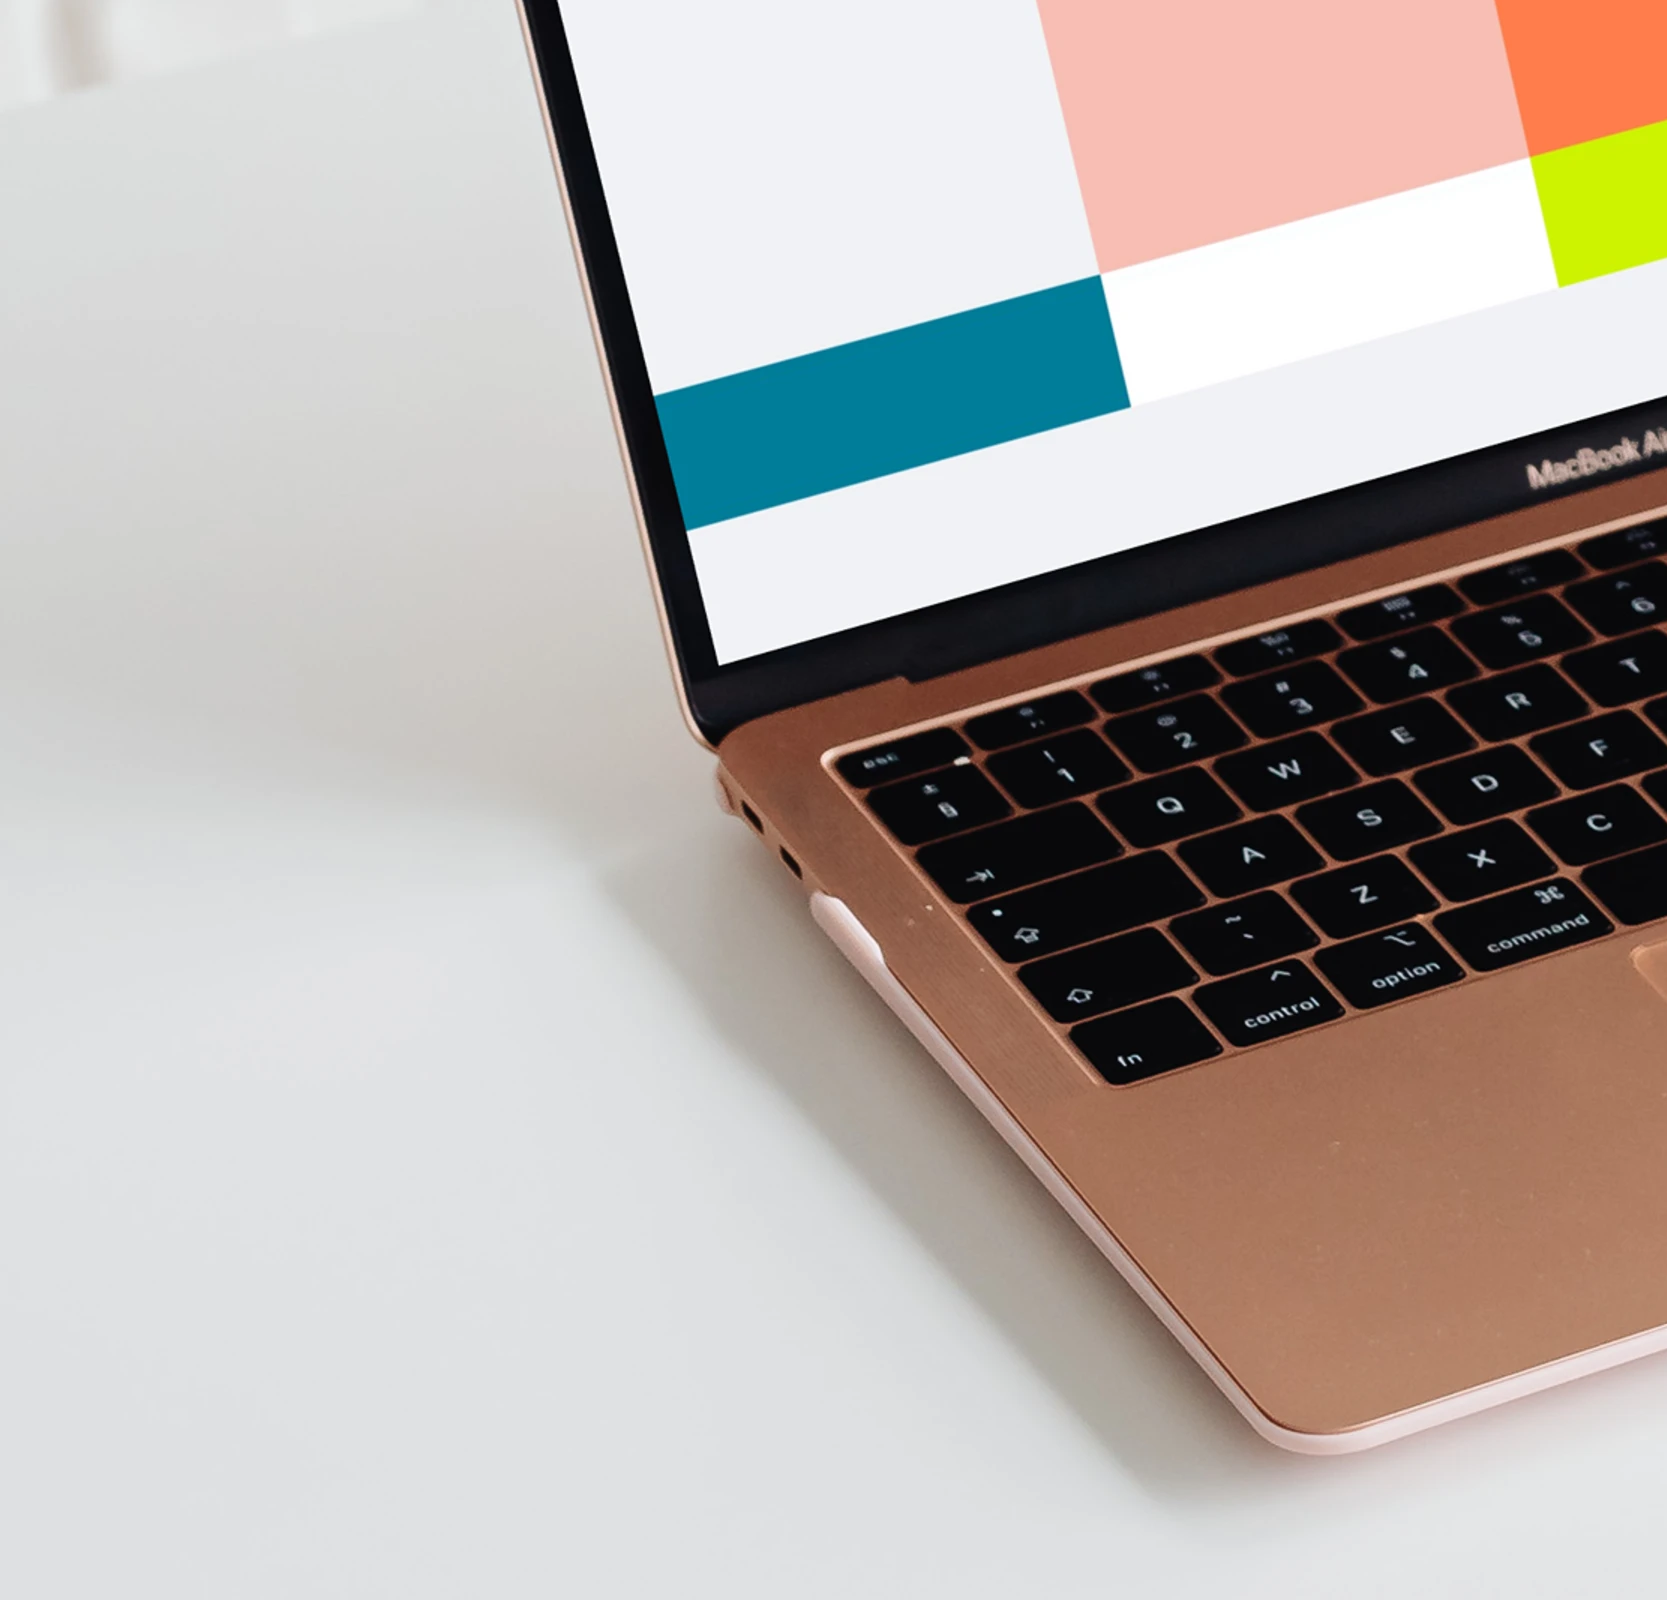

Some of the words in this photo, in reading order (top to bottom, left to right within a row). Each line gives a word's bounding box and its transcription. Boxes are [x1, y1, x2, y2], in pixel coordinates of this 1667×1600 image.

[1525, 436, 1641, 490] MacBook
[1156, 796, 1185, 814] Q
[1267, 758, 1302, 780] W
[1389, 726, 1415, 745] E
[1504, 692, 1532, 710] R
[1619, 657, 1641, 674] T
[1173, 731, 1197, 749] 2
[1289, 697, 1314, 715] 3
[1242, 846, 1266, 865] A
[1356, 808, 1383, 827] S
[1470, 774, 1499, 793] D
[1588, 739, 1608, 757] F
[1350, 884, 1379, 905] Z
[1466, 848, 1497, 869] X
[1586, 813, 1613, 832] C
[1117, 1053, 1143, 1068] fn
[1243, 996, 1321, 1029] control
[1371, 961, 1441, 989] option
[1486, 913, 1590, 953] command
